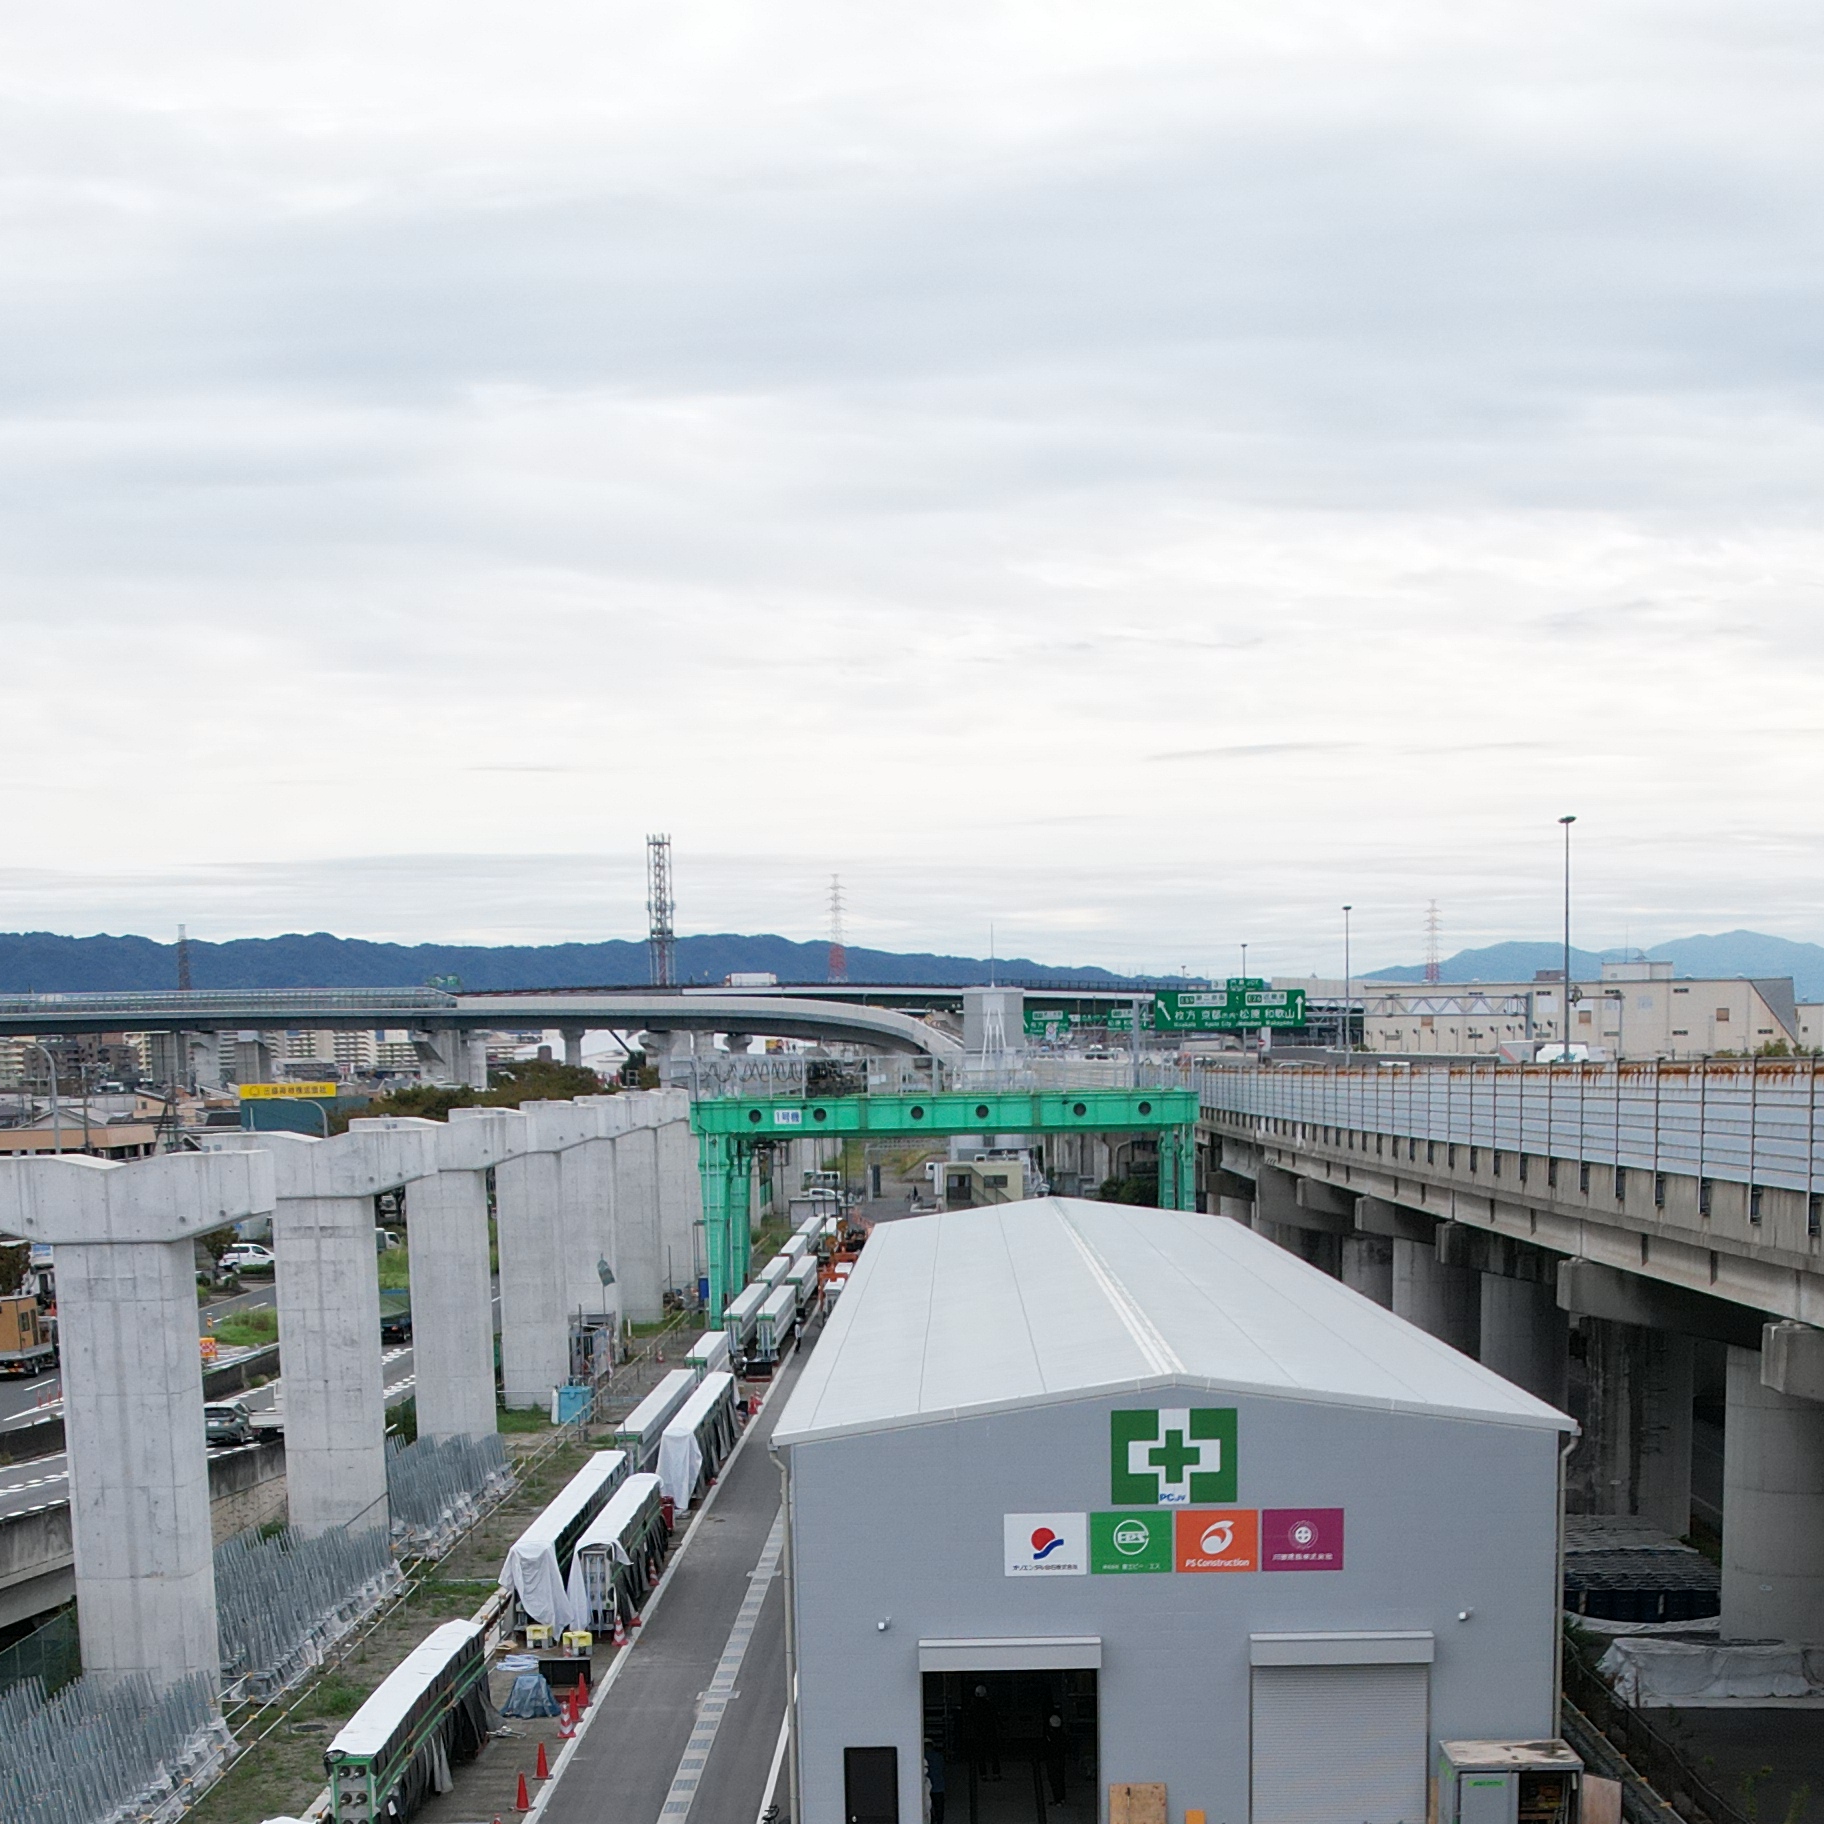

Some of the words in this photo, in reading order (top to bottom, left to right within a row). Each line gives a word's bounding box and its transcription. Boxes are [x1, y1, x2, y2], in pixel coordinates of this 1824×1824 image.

[1264, 1008, 1295, 1019] 和歌山
[1185, 1558, 1196, 1567] PS
[1196, 1557, 1250, 1567] Construction
